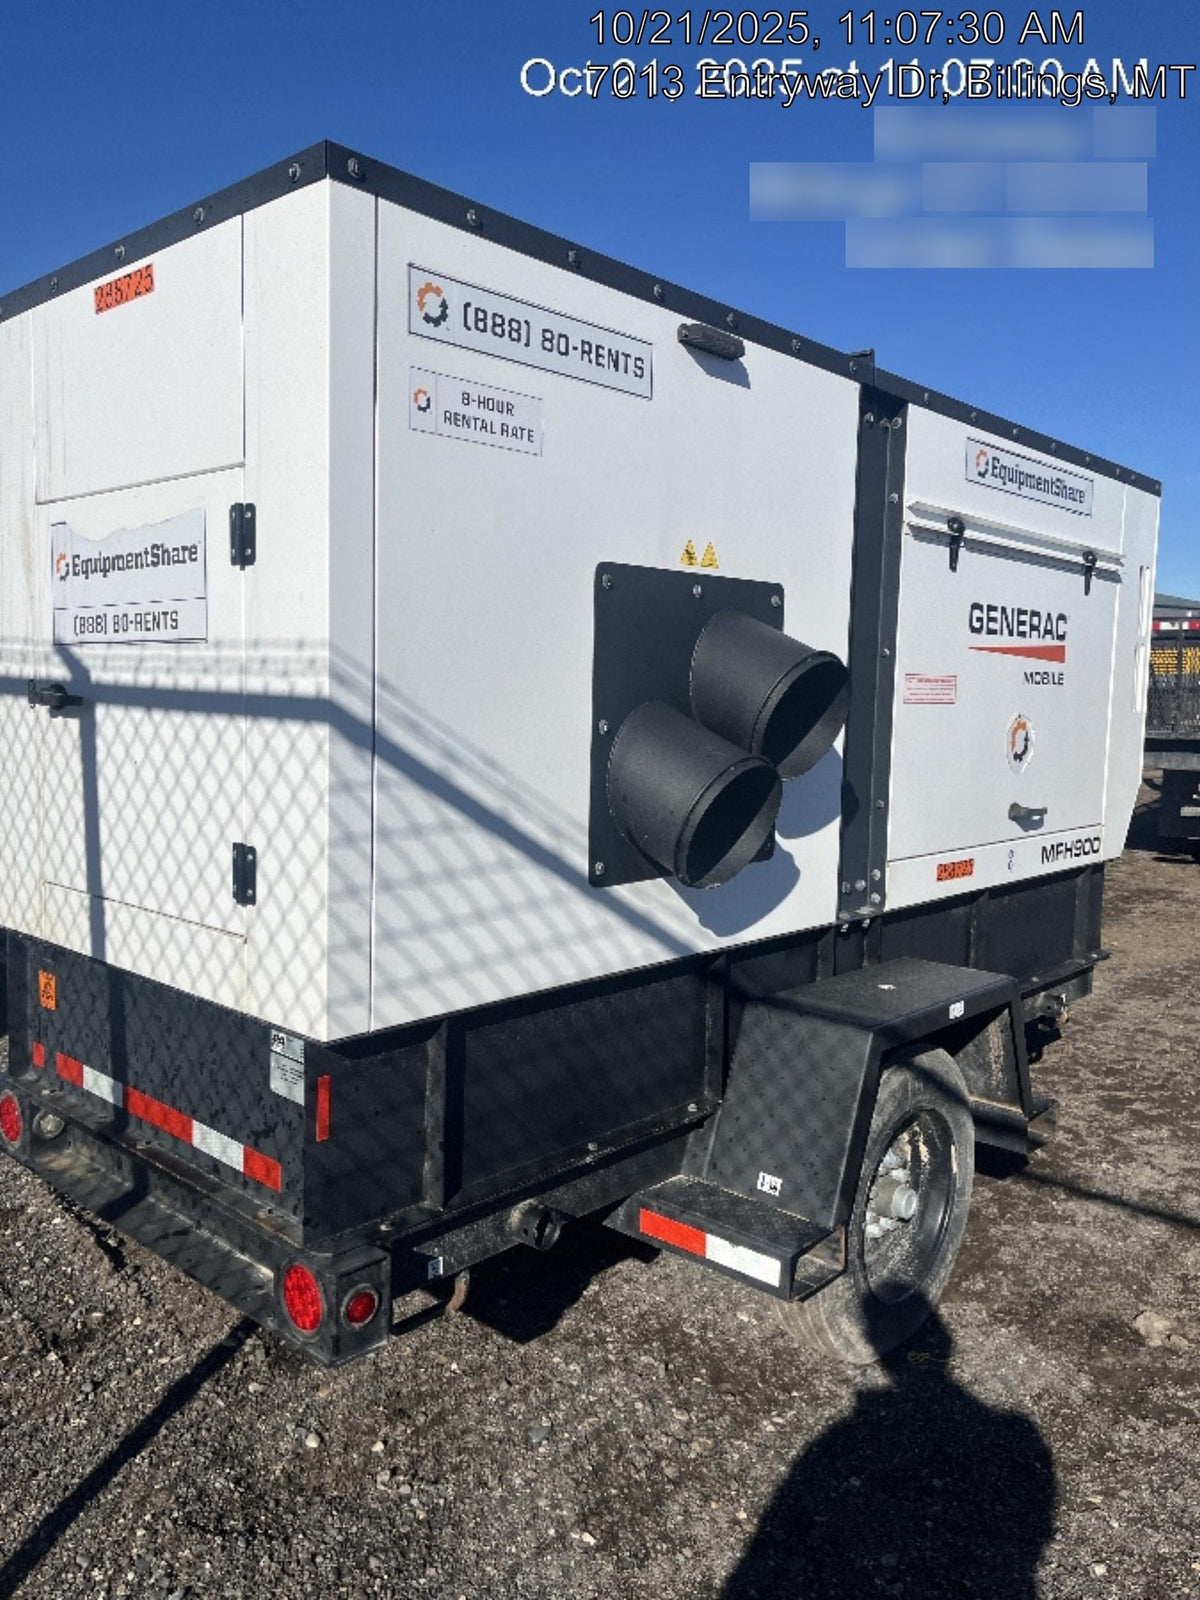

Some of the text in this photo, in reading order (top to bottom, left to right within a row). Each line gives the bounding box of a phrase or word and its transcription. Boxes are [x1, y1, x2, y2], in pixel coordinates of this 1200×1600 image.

[463, 301, 645, 380] (888) 80-RENTS
[461, 391, 515, 417] 8-HOUR
[444, 410, 535, 443] RENTAL RATE
[990, 456, 1086, 504] EquipmentShare
[71, 542, 199, 580] EquipmentShare
[73, 611, 179, 636] (888) 80-RENTS
[968, 602, 1068, 642] GENERAC
[1023, 671, 1065, 686] MOBILE
[1040, 837, 1102, 865] MFH900
